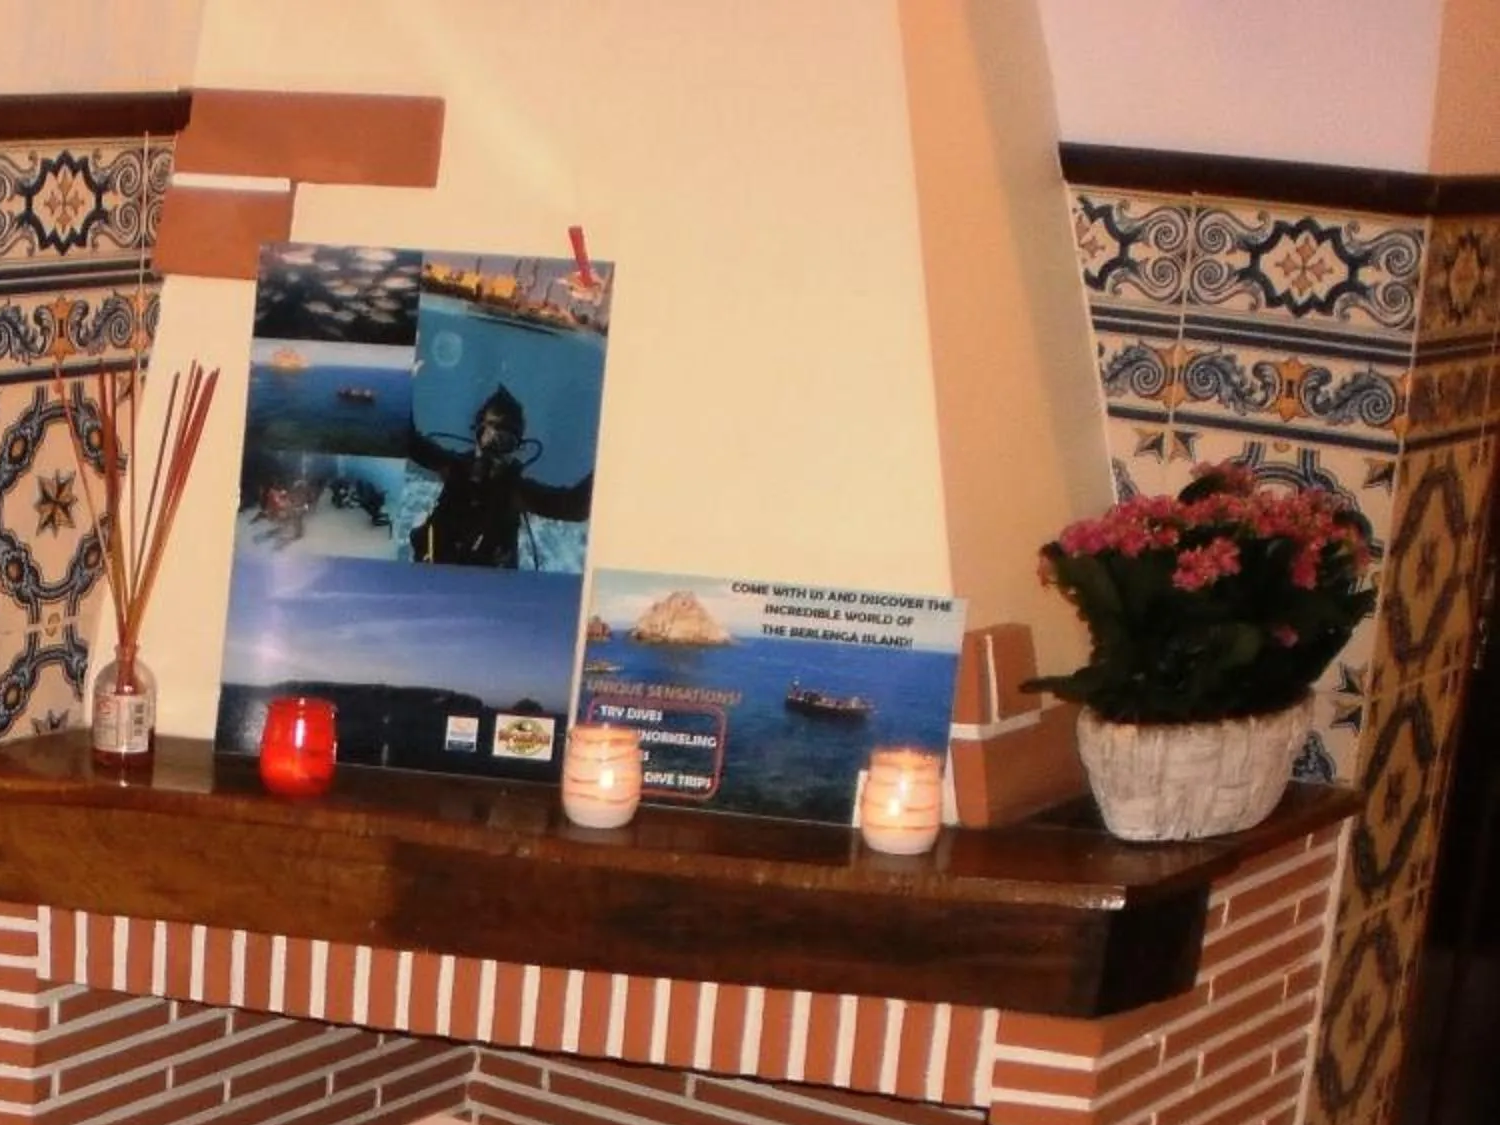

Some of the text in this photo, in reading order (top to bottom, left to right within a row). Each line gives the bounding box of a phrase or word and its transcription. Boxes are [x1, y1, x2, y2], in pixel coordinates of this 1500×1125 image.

[731, 582, 952, 612] COME WITH US AND DISCOVER THE
[765, 603, 914, 627] INCREDIBLE WORLD OF
[762, 624, 788, 636] THE
[789, 626, 859, 642] BERLENGA
[587, 680, 645, 698] UNIQUE
[600, 704, 625, 717] TRY
[638, 729, 717, 748] NORKELING
[644, 771, 674, 785] DIVE
